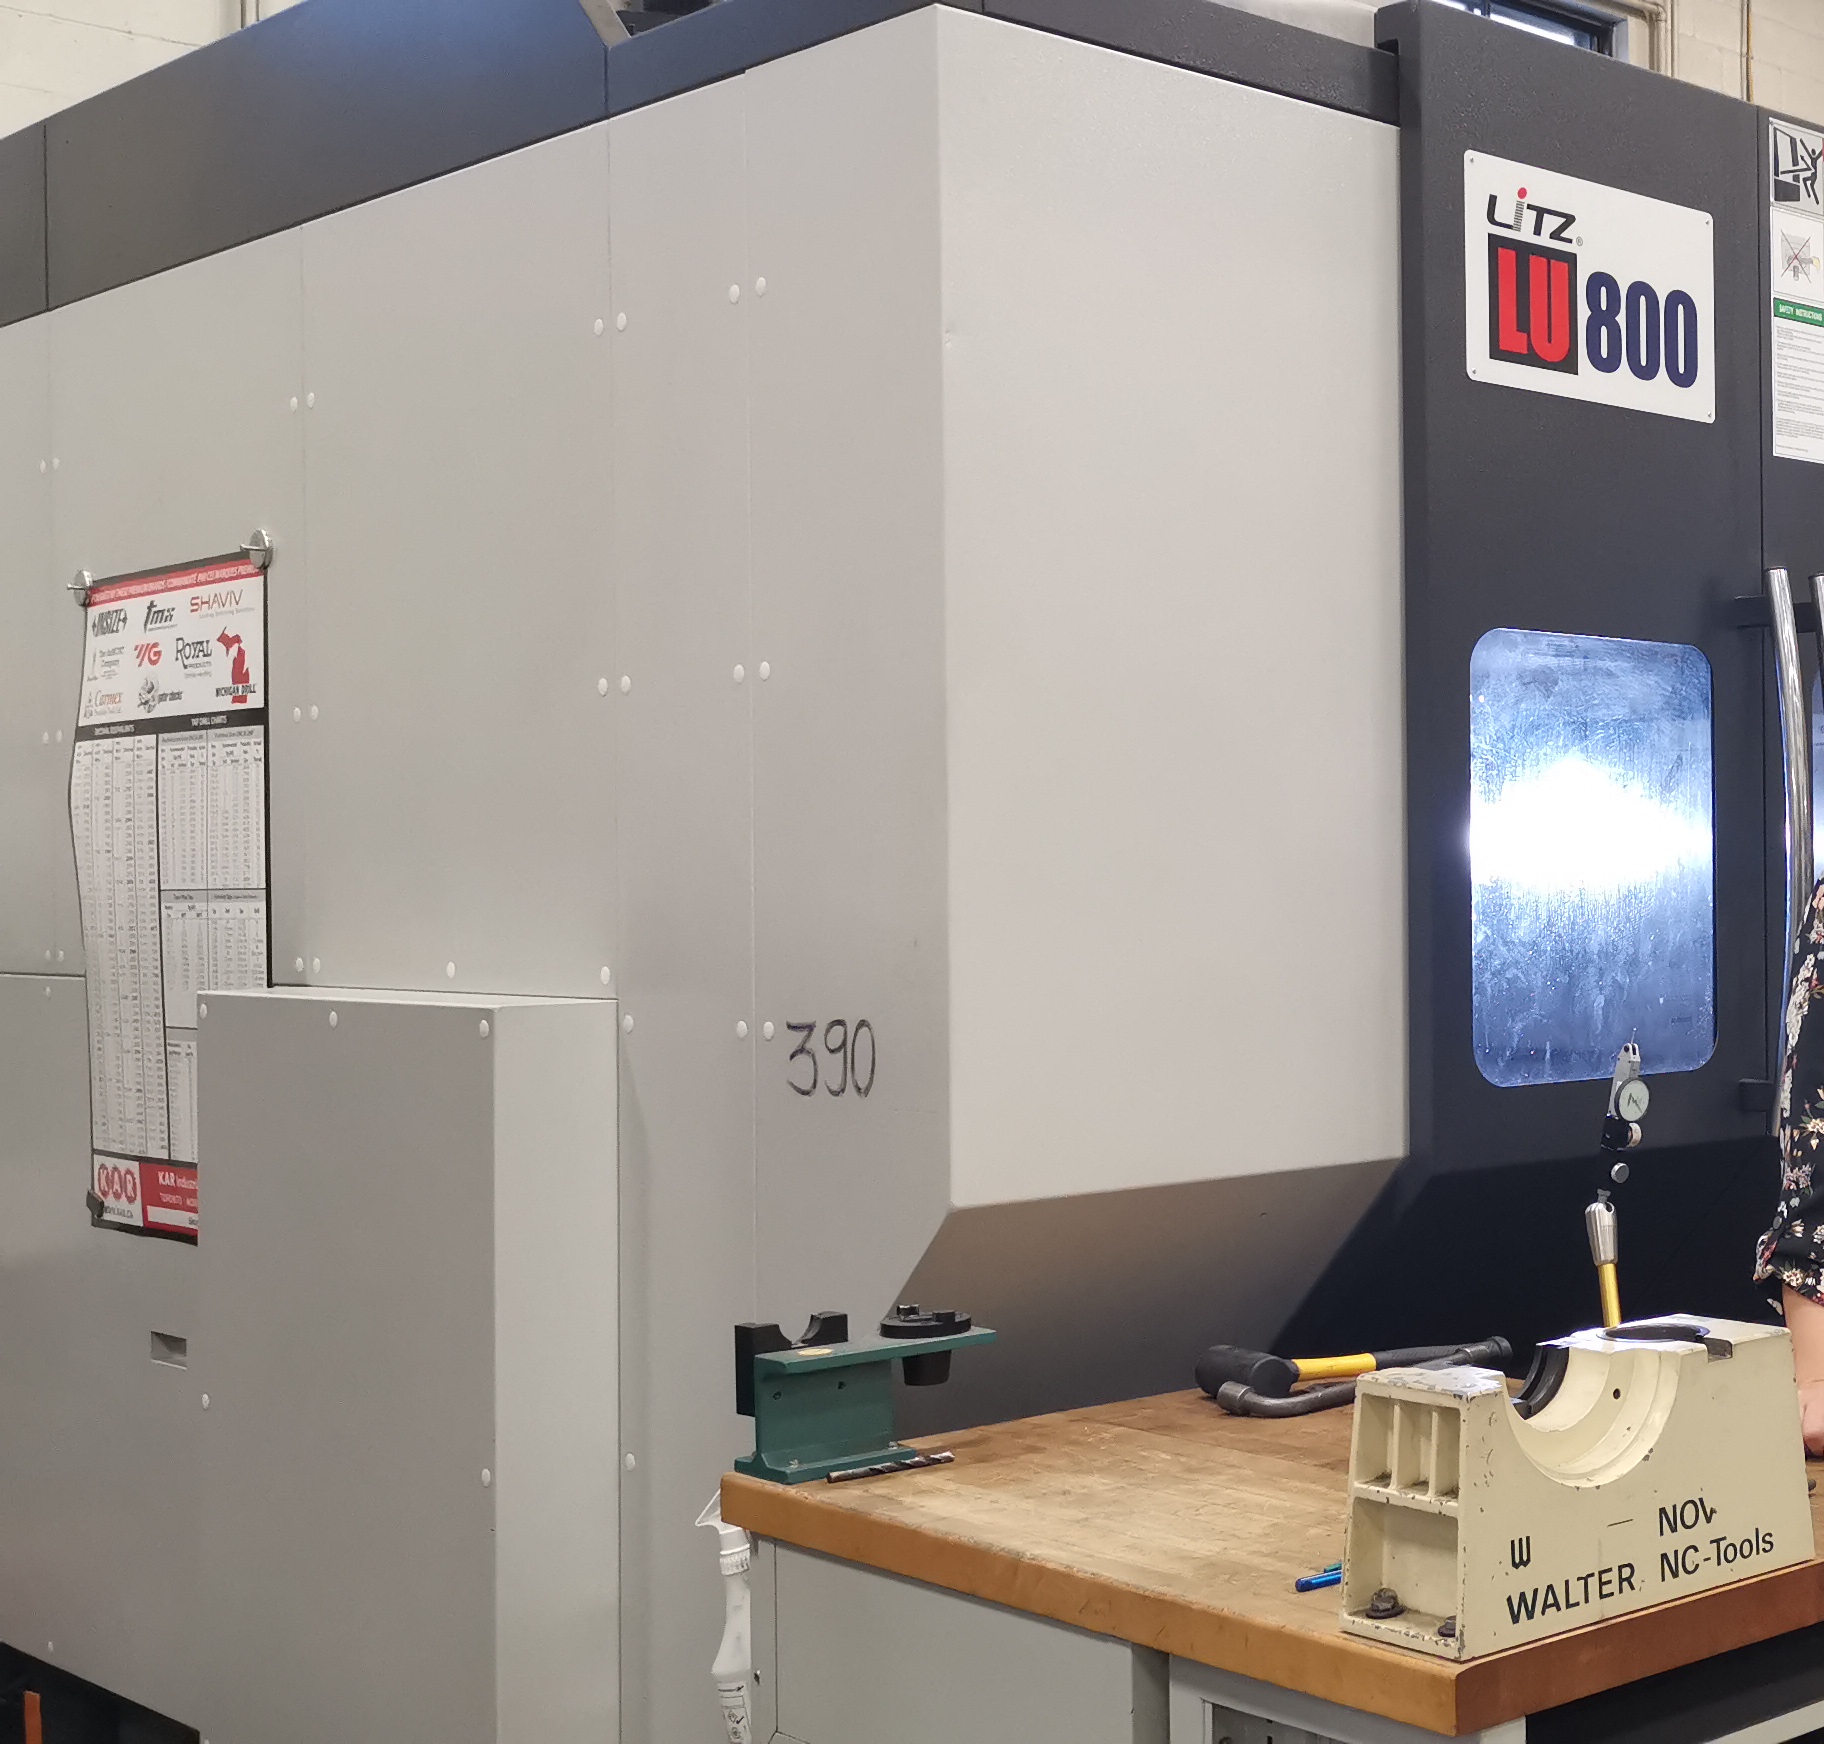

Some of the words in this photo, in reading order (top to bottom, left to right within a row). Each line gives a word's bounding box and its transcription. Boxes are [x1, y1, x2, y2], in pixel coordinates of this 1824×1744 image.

[1498, 247, 1571, 363] LU
[1586, 271, 1698, 388] 800
[190, 589, 243, 613] SHAVIV
[786, 1019, 875, 1097] 390
[99, 1166, 136, 1200] KAR
[158, 1171, 176, 1188] KAR
[1506, 1562, 1636, 1626] WALTER
[1660, 1528, 1774, 1582] NC-Tools
